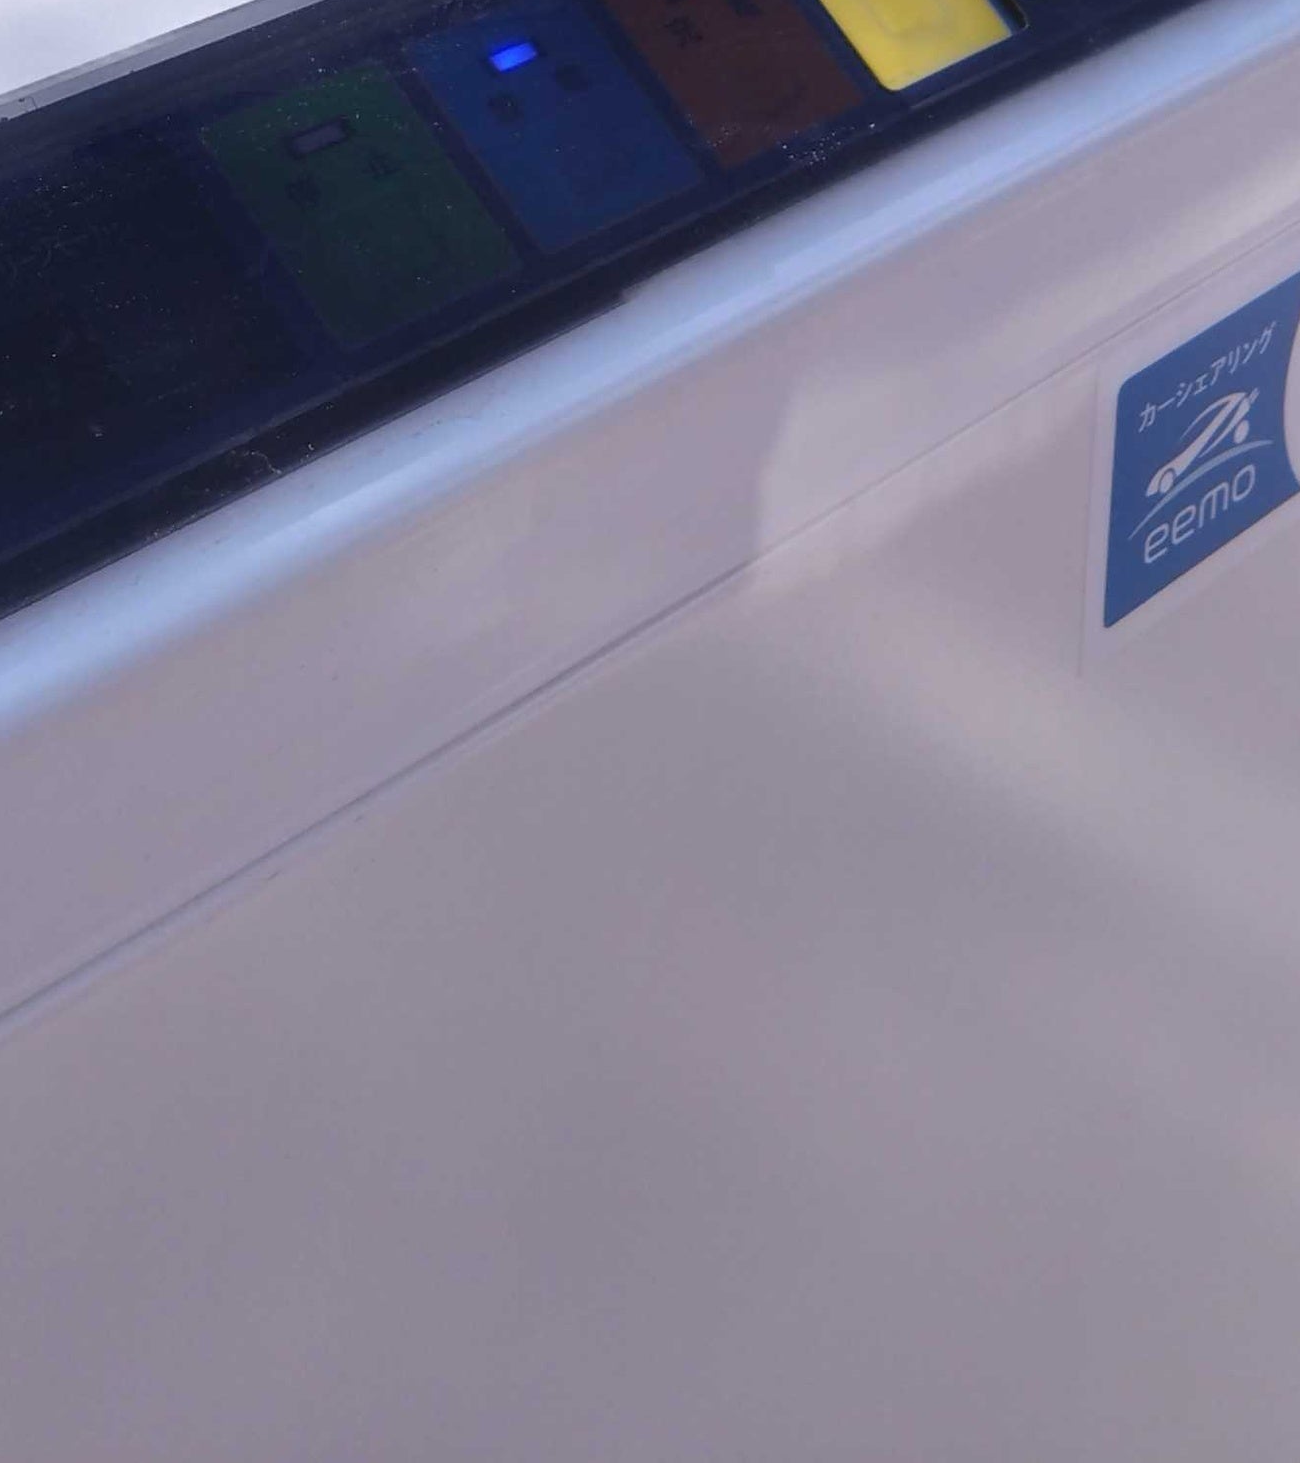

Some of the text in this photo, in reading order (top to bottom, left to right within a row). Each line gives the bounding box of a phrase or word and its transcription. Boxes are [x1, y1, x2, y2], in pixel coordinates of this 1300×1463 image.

[1138, 320, 1278, 434] カーシェアリング
[1143, 463, 1257, 565] eemo
